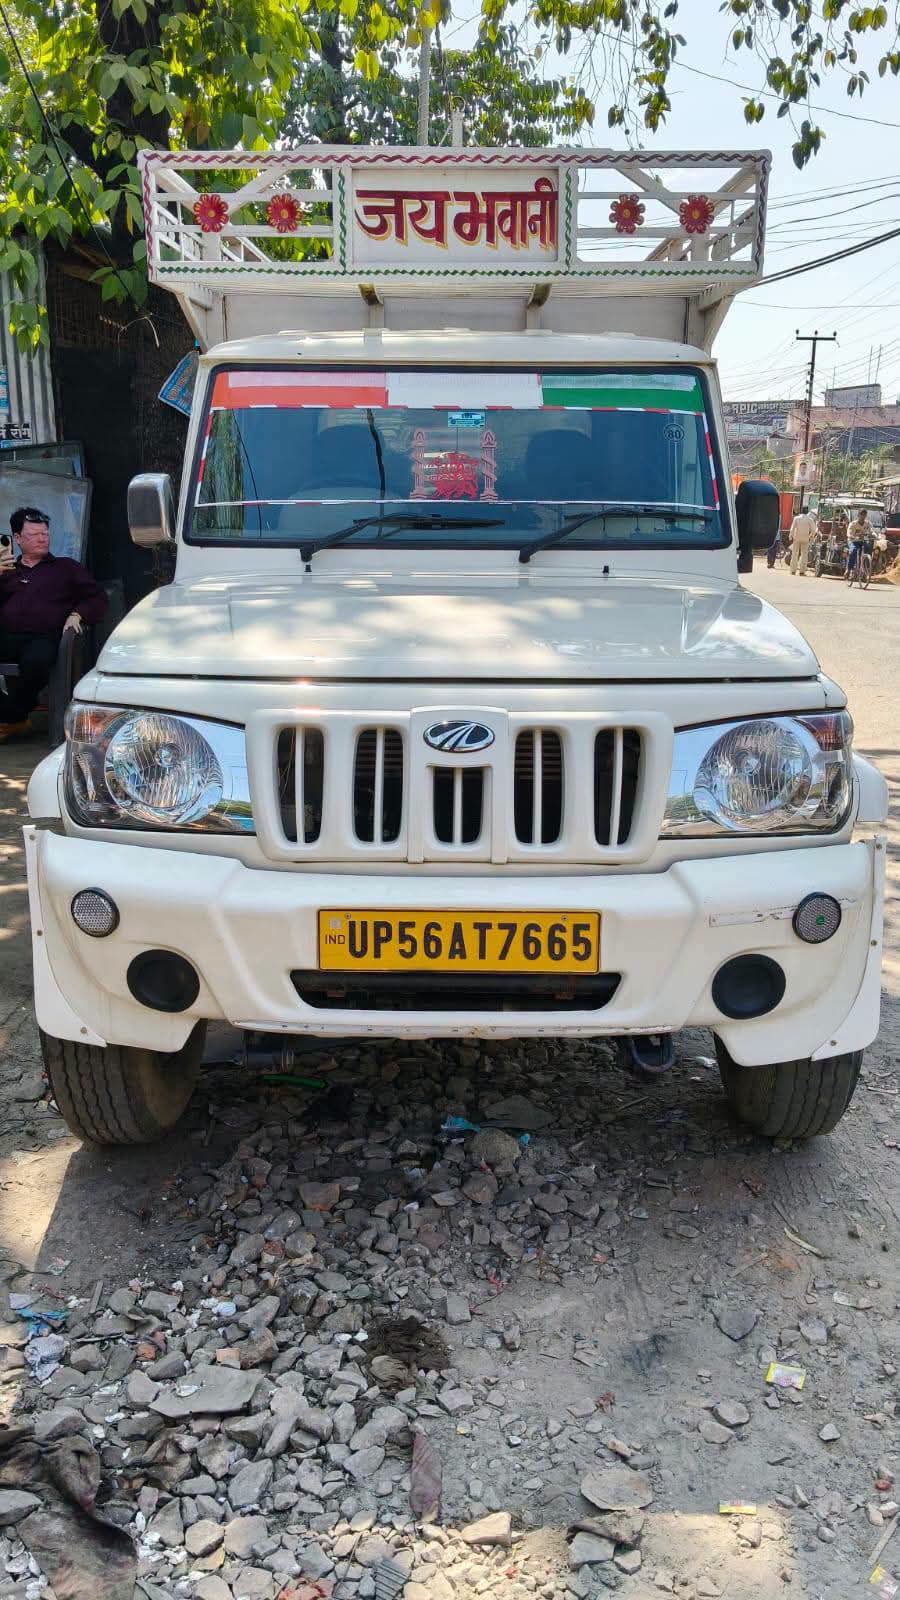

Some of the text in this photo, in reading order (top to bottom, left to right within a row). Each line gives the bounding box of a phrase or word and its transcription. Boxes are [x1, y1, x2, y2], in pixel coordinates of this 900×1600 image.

[667, 429, 681, 440] 80
[325, 934, 346, 945] IND
[348, 920, 592, 961] UP56AT7665
